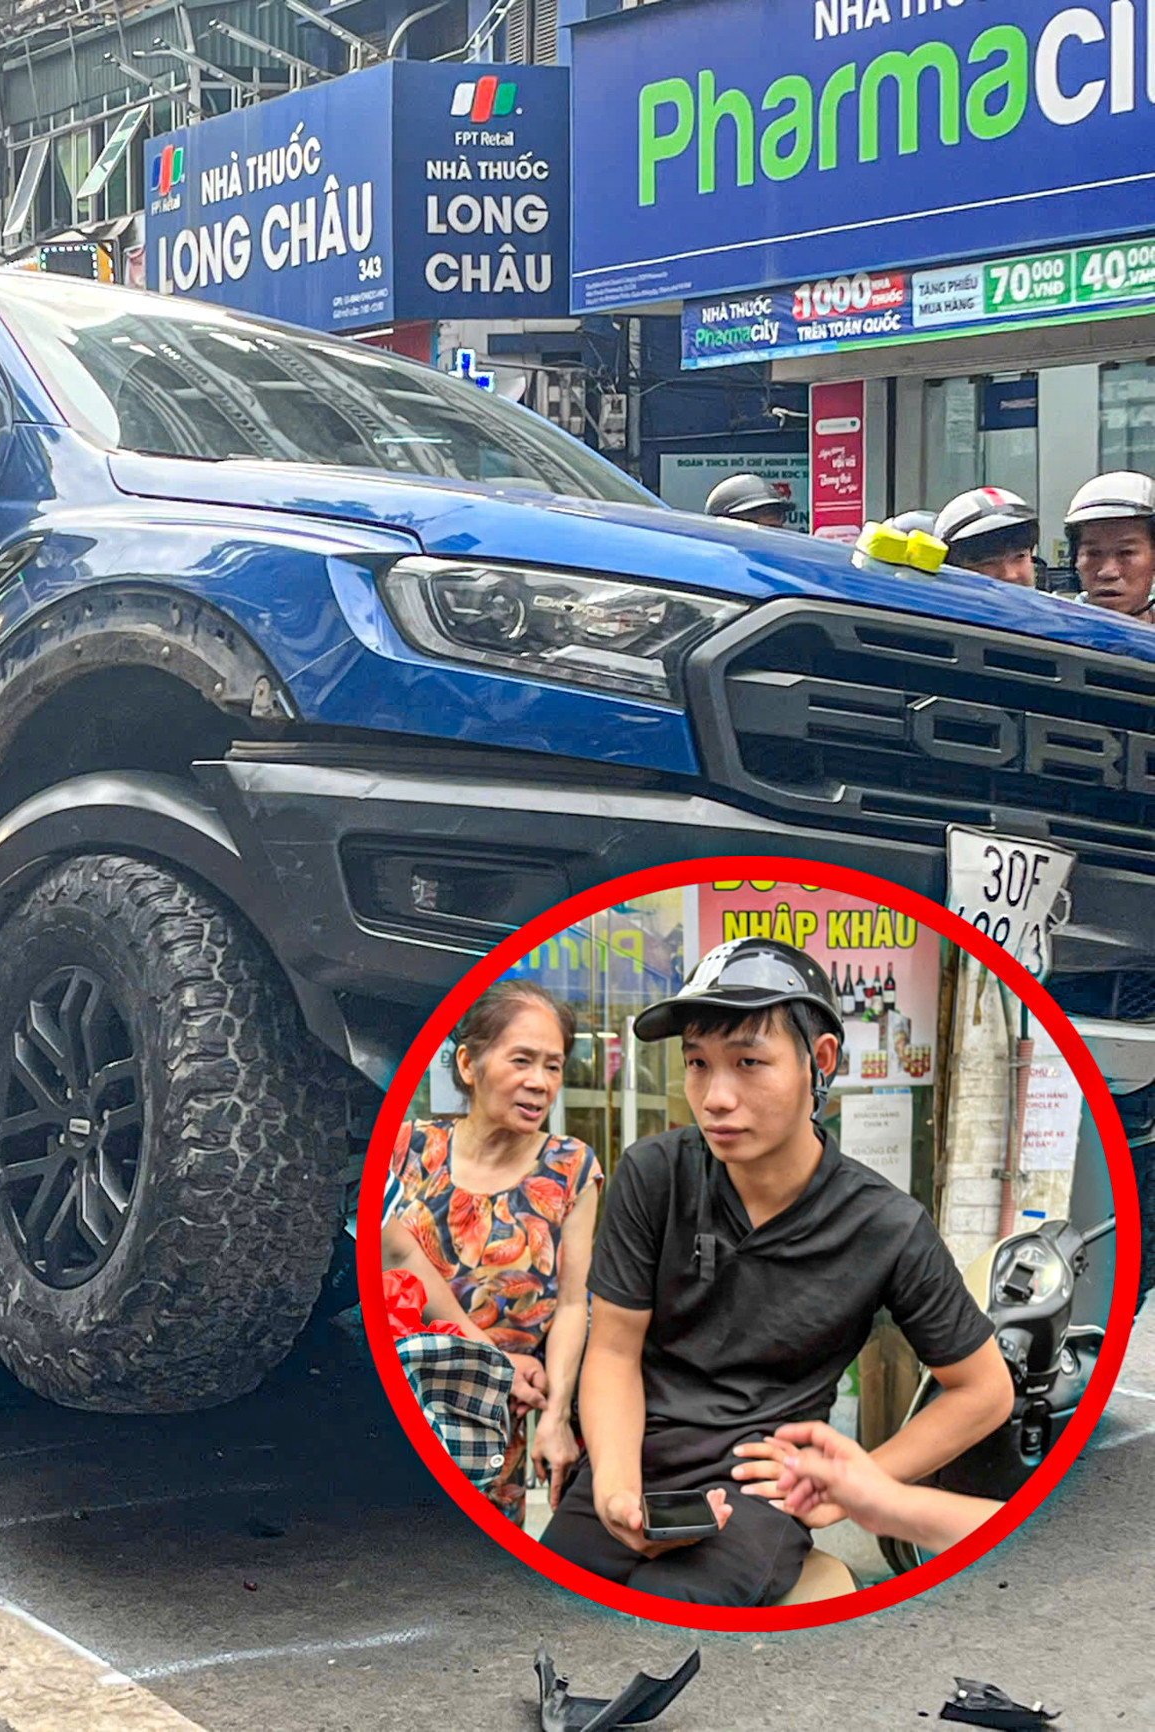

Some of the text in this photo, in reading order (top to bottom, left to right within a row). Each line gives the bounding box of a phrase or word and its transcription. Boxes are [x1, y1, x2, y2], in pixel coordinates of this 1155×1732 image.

[455, 131, 514, 146] FPT Retail
[201, 122, 321, 206] NHÀ THUỐC
[426, 151, 549, 180] NHÀ THUỐC
[427, 194, 549, 234] LONG
[159, 174, 372, 296] LONG CHÂU
[358, 256, 382, 281] 343
[425, 243, 552, 293] CHÂU
[990, 258, 1064, 304] 70 000
[1081, 250, 1126, 291] 40
[702, 294, 772, 324] NHÀ THUỐC
[794, 271, 872, 319] 1000
[919, 301, 943, 316] MUA
[863, 310, 902, 334] QUỐC
[983, 845, 1050, 911] 30F
